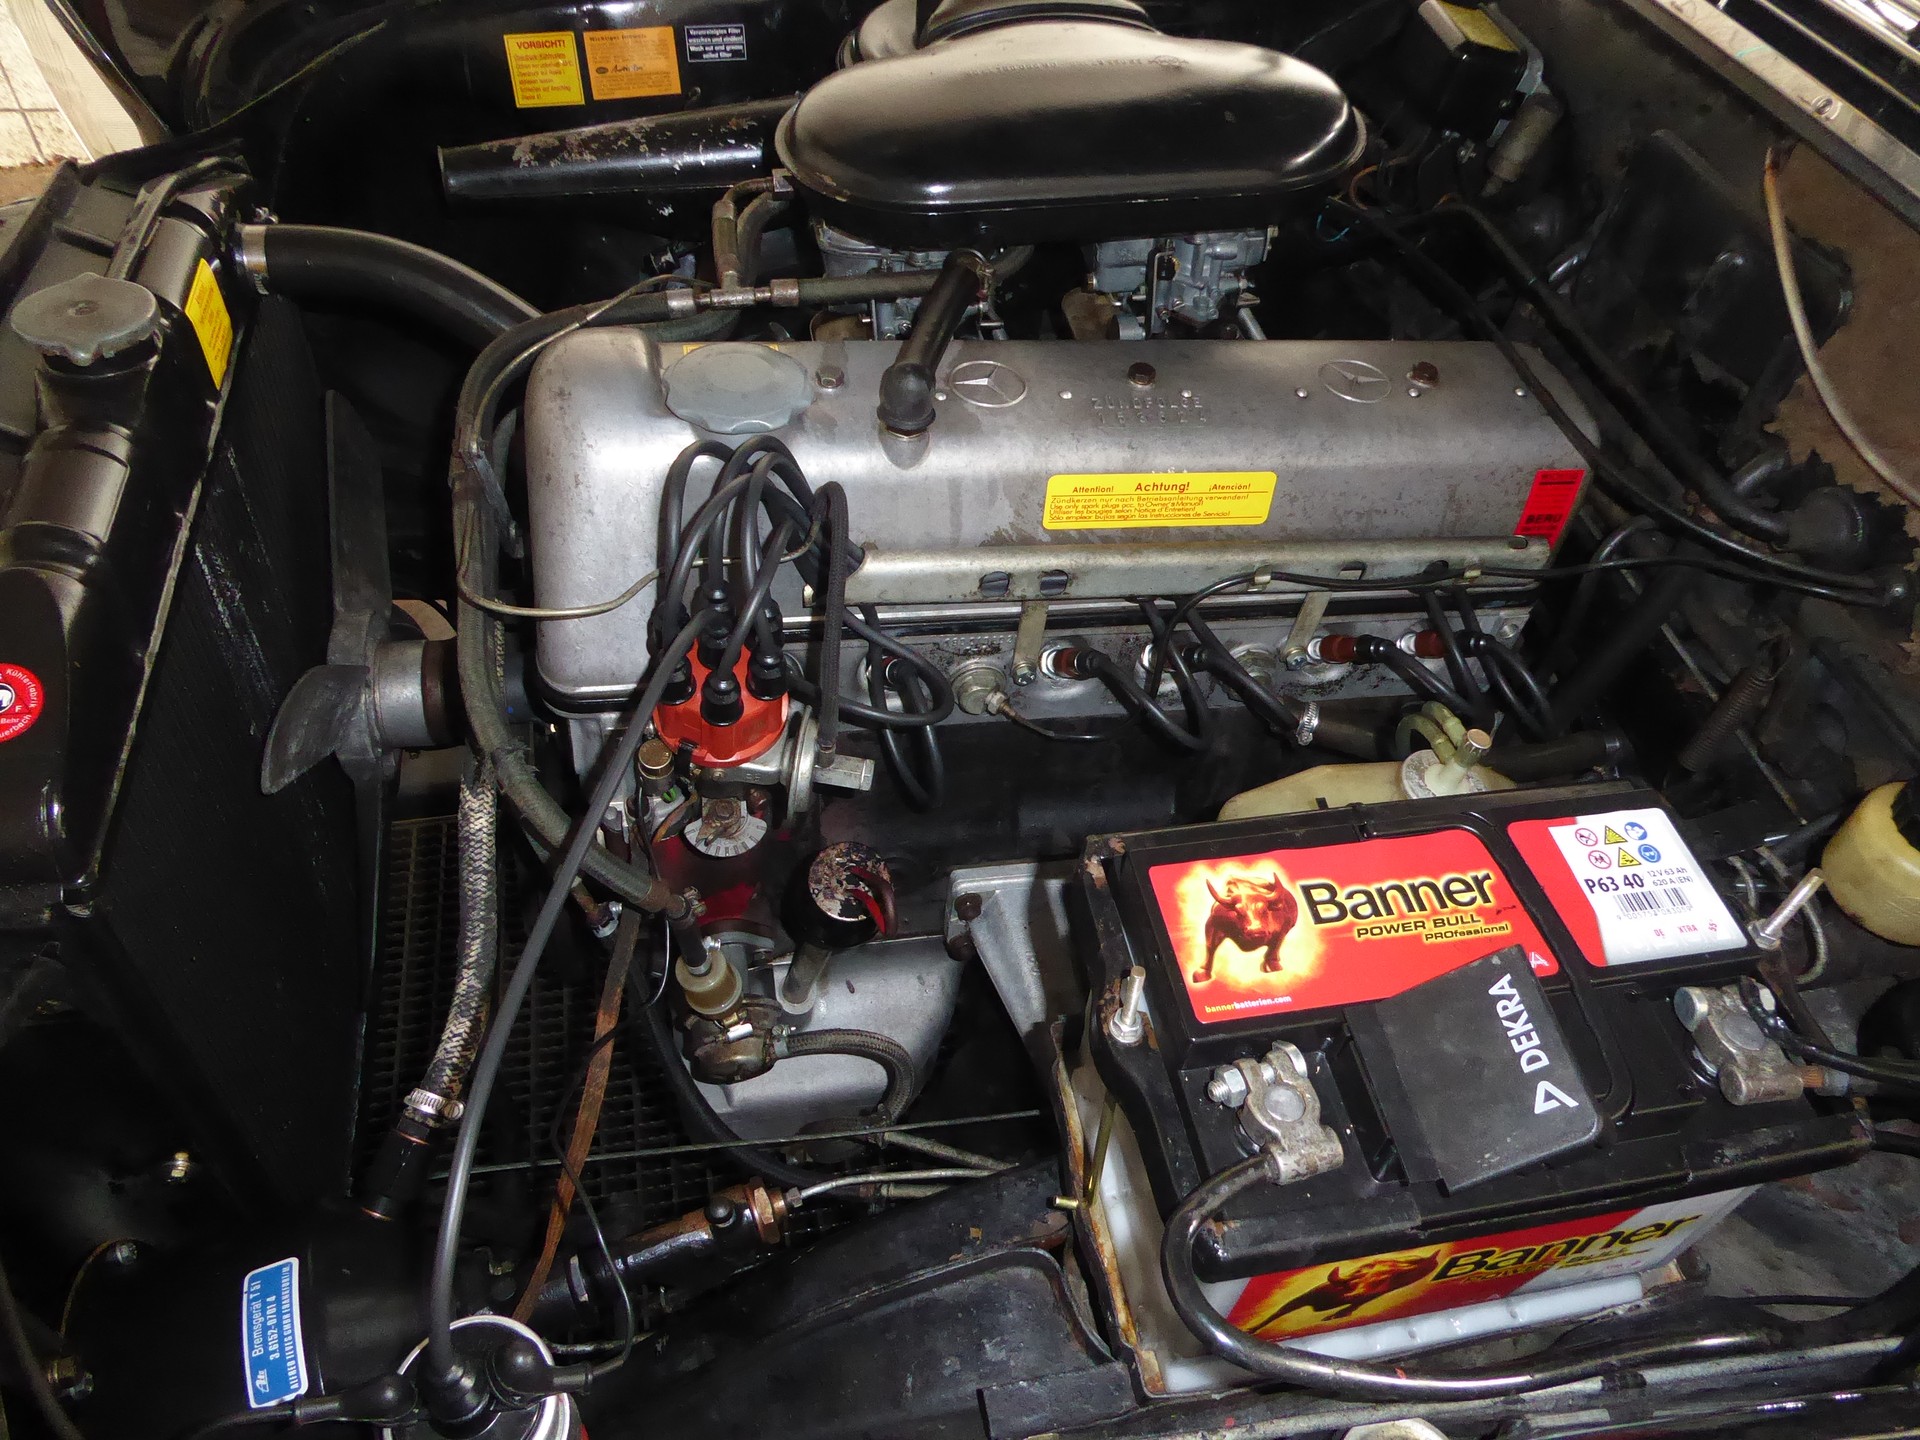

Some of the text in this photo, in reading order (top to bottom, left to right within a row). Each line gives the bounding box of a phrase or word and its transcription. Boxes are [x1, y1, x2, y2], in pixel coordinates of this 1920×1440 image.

[516, 40, 566, 50] VORSICHT!
[1072, 486, 1114, 494] Attention!
[1134, 482, 1190, 494] Achtung!
[1652, 878, 1669, 887] 620
[1675, 875, 1694, 885] (EN)
[1664, 868, 1675, 876] 63
[1583, 872, 1645, 894] P63 40
[1299, 872, 1493, 926] Banner
[1357, 913, 1482, 939] POWER BULL
[1425, 923, 1510, 942] PROfessional
[1204, 995, 1293, 1013] bannerbatterien.com
[1488, 972, 1550, 1074] DEKRA
[1430, 1214, 1704, 1282] Banner
[249, 1280, 265, 1357] Bremsgerät T 51
[286, 1359, 300, 1390] ALFRED
